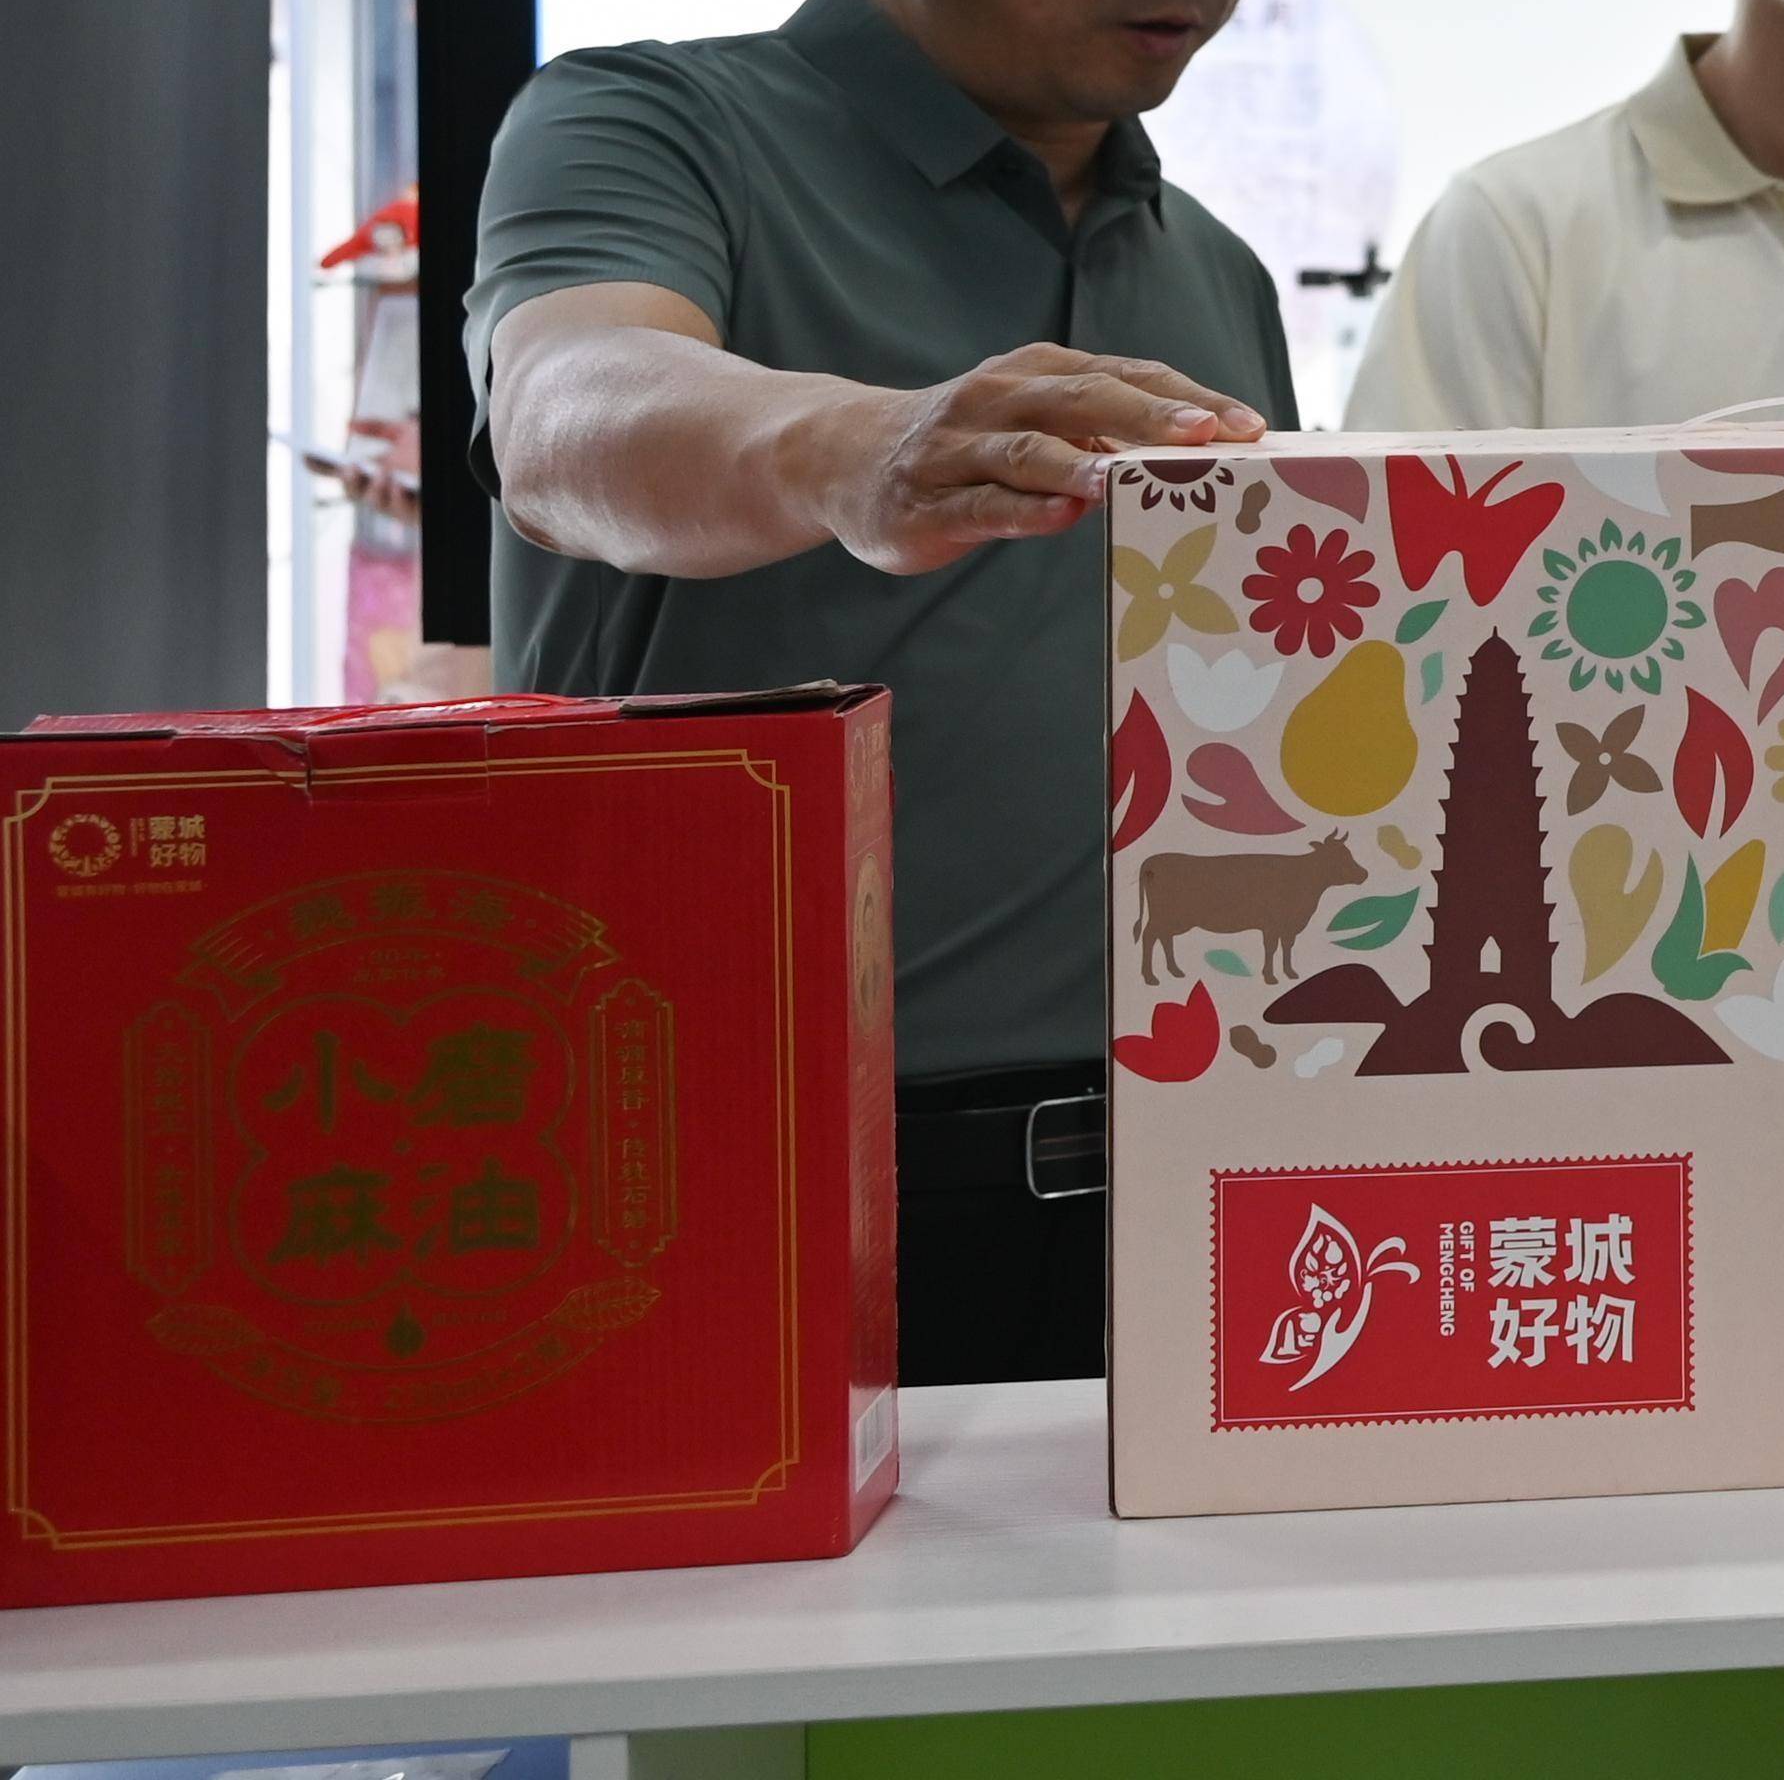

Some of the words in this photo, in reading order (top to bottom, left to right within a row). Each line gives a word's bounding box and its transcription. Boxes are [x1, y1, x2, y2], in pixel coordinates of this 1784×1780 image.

[149, 814, 206, 841] 蒙城
[150, 842, 207, 868] 好物
[257, 1021, 541, 1136] 小磨
[265, 1152, 543, 1268] 麻油
[1458, 1220, 1476, 1260] GIFT
[1438, 1222, 1457, 1338] MENGCHENG
[1458, 1267, 1476, 1293] OF
[1488, 1212, 1636, 1289] 蒙城
[1487, 1293, 1637, 1369] 好物
